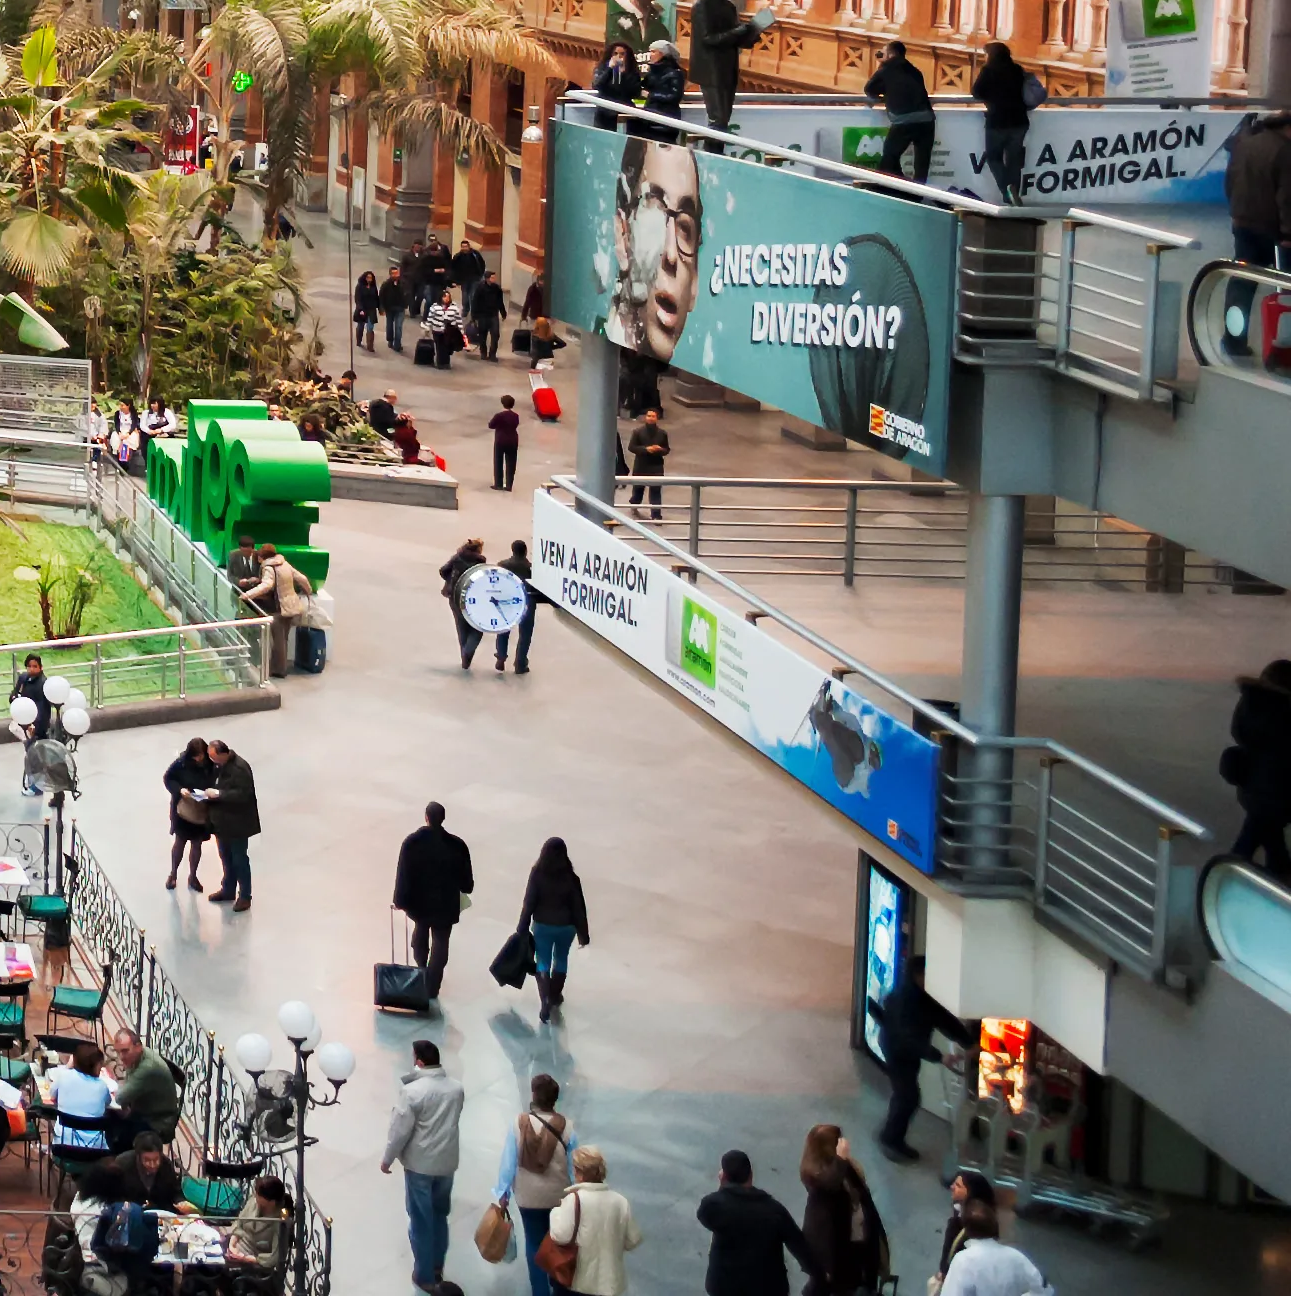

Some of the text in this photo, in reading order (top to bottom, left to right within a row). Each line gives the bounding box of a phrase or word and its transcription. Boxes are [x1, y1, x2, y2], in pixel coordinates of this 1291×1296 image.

[1036, 143, 1057, 166] A
[1067, 119, 1205, 162] ARAMÓN
[1020, 155, 1187, 197] FORMIGAL.
[709, 243, 849, 295] ¿NECESITAS
[751, 289, 902, 351] DIVERSIÓN?
[540, 538, 649, 596] VEN A ARAMÓN
[561, 577, 638, 627] FORMIGAL.
